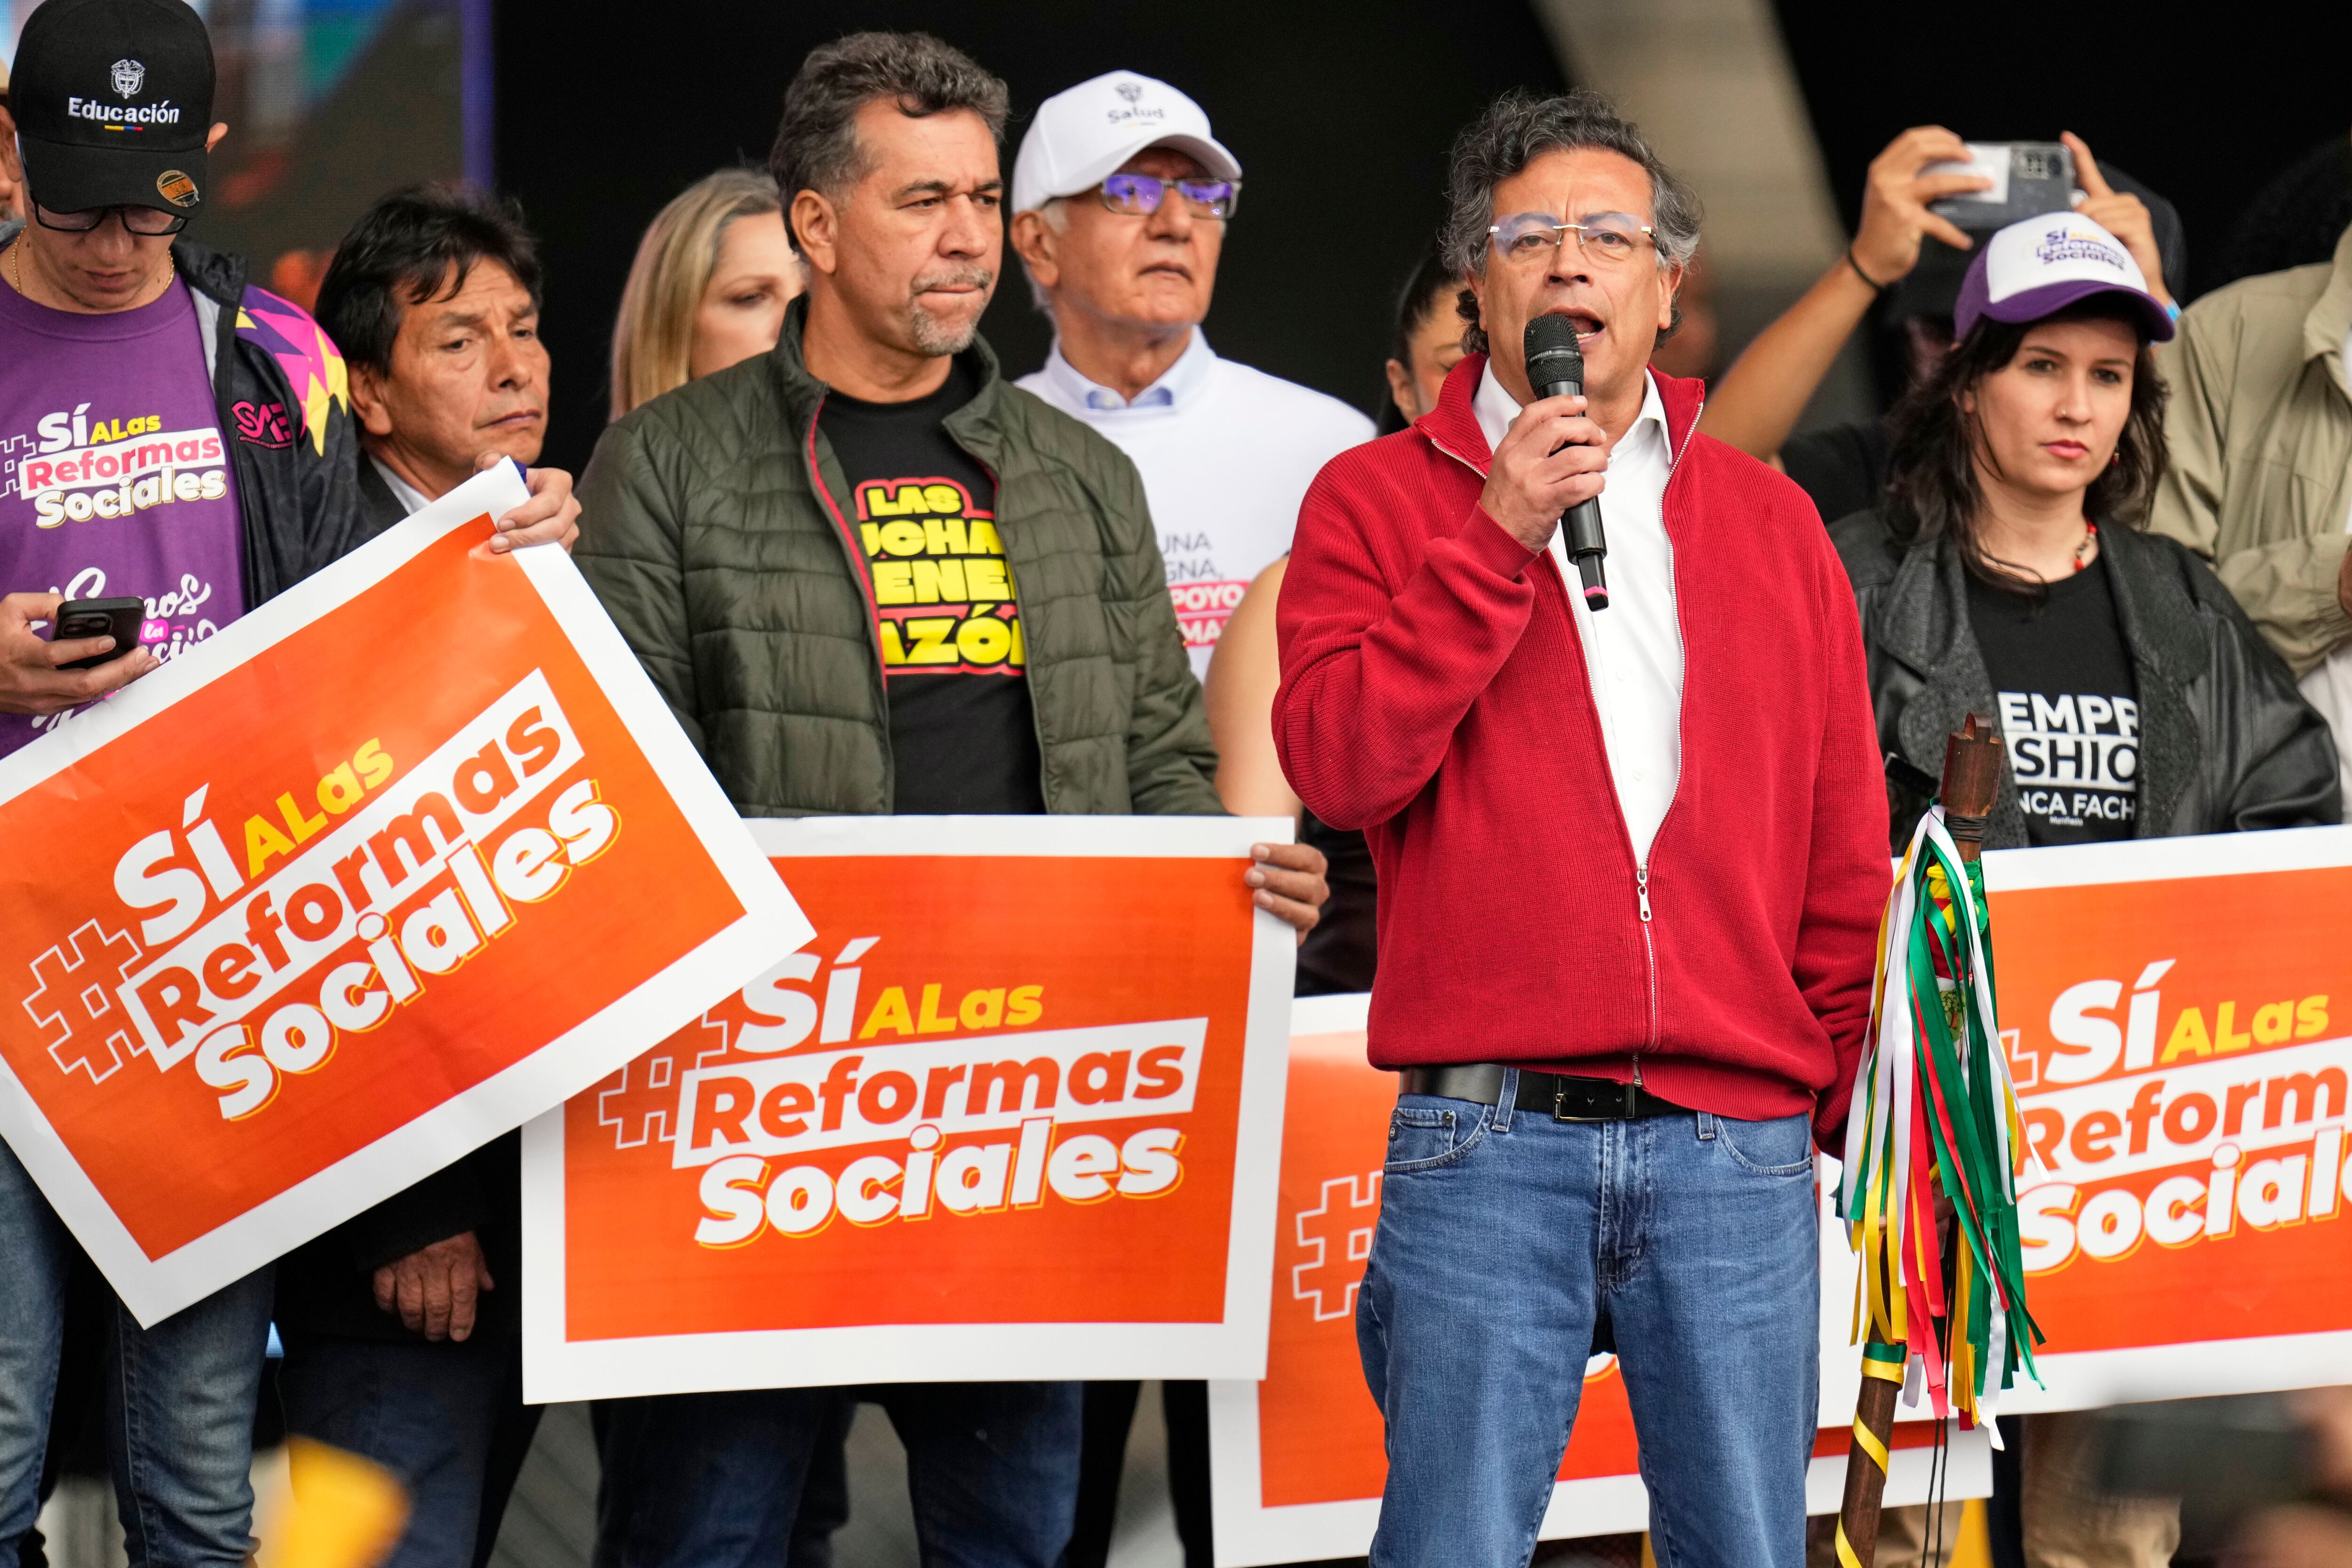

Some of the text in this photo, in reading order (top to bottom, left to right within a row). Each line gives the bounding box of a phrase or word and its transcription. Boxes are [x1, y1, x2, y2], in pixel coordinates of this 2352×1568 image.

[68, 97, 180, 124] Educación
[1107, 107, 1165, 124] Salud
[26, 436, 221, 491] Reformas
[34, 467, 227, 529] Sociales
[867, 485, 961, 517] LAS
[872, 558, 1016, 605] ENE
[1180, 619, 1227, 643] MA
[136, 705, 561, 1049] Reformas
[195, 779, 622, 1122] Sociales
[690, 1044, 1187, 1150] Reformas
[694, 1118, 1187, 1250] Sociales
